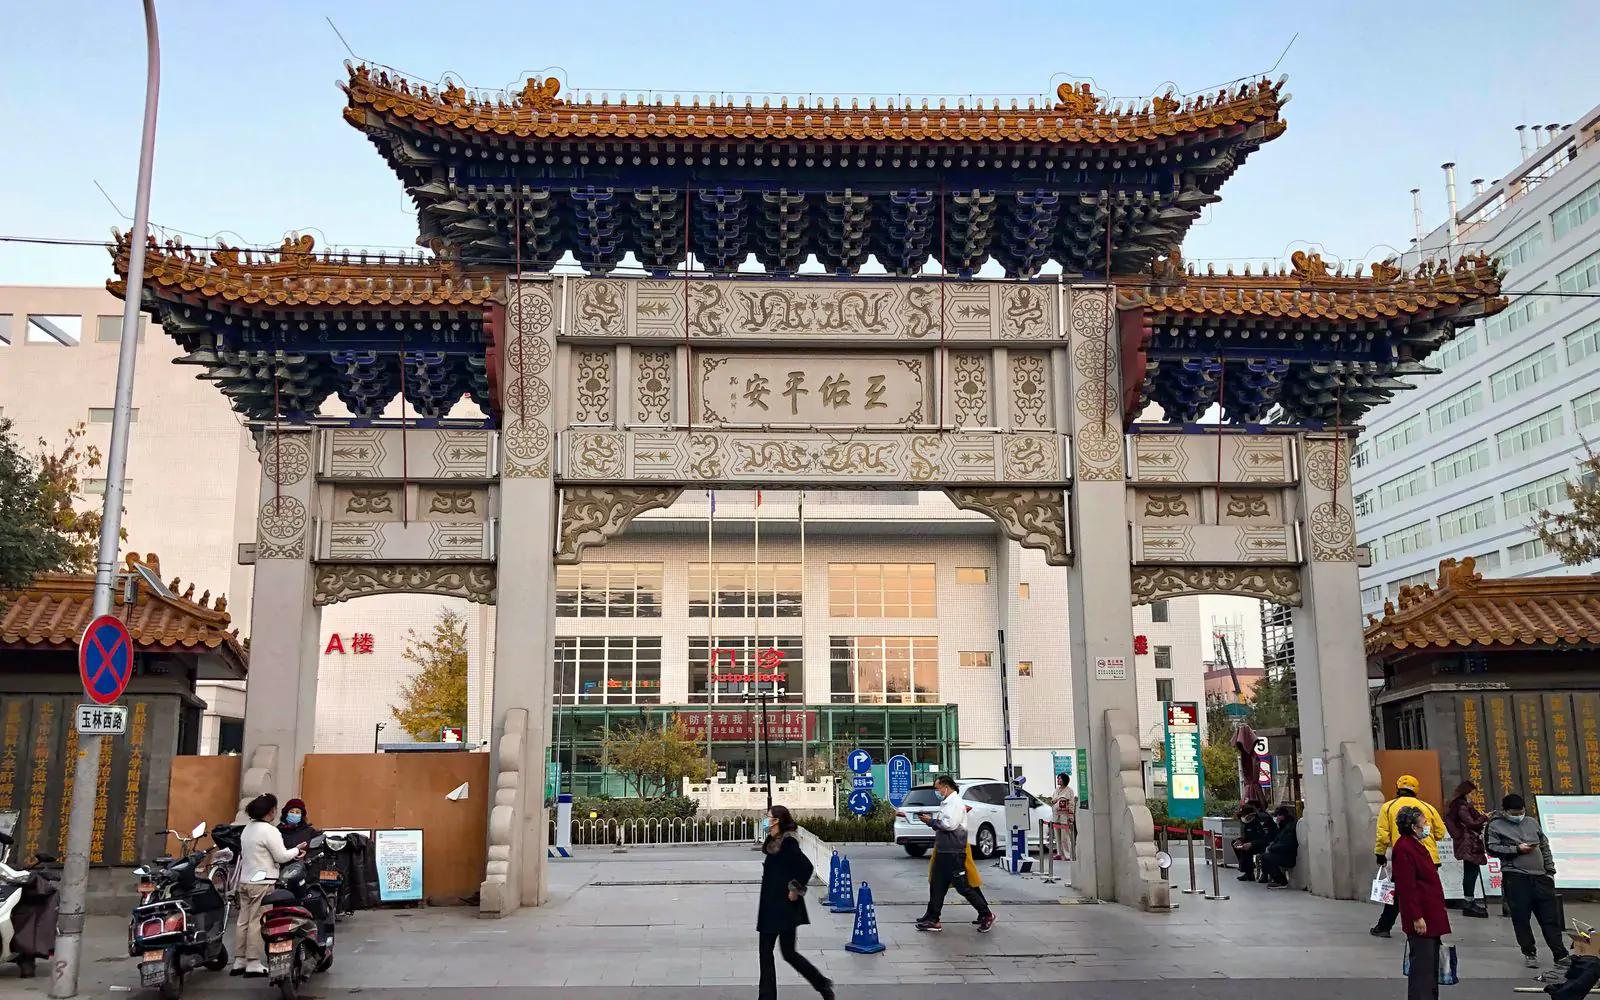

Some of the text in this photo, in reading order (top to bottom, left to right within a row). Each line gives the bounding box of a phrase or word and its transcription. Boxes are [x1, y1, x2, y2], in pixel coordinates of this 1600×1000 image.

[324, 632, 375, 655] A楼
[707, 647, 785, 669] 门诊
[82, 710, 123, 730] 玉林西路
[1257, 739, 1266, 752] 5
[120, 703, 147, 863] 首都医科大学附属北京佑安医院
